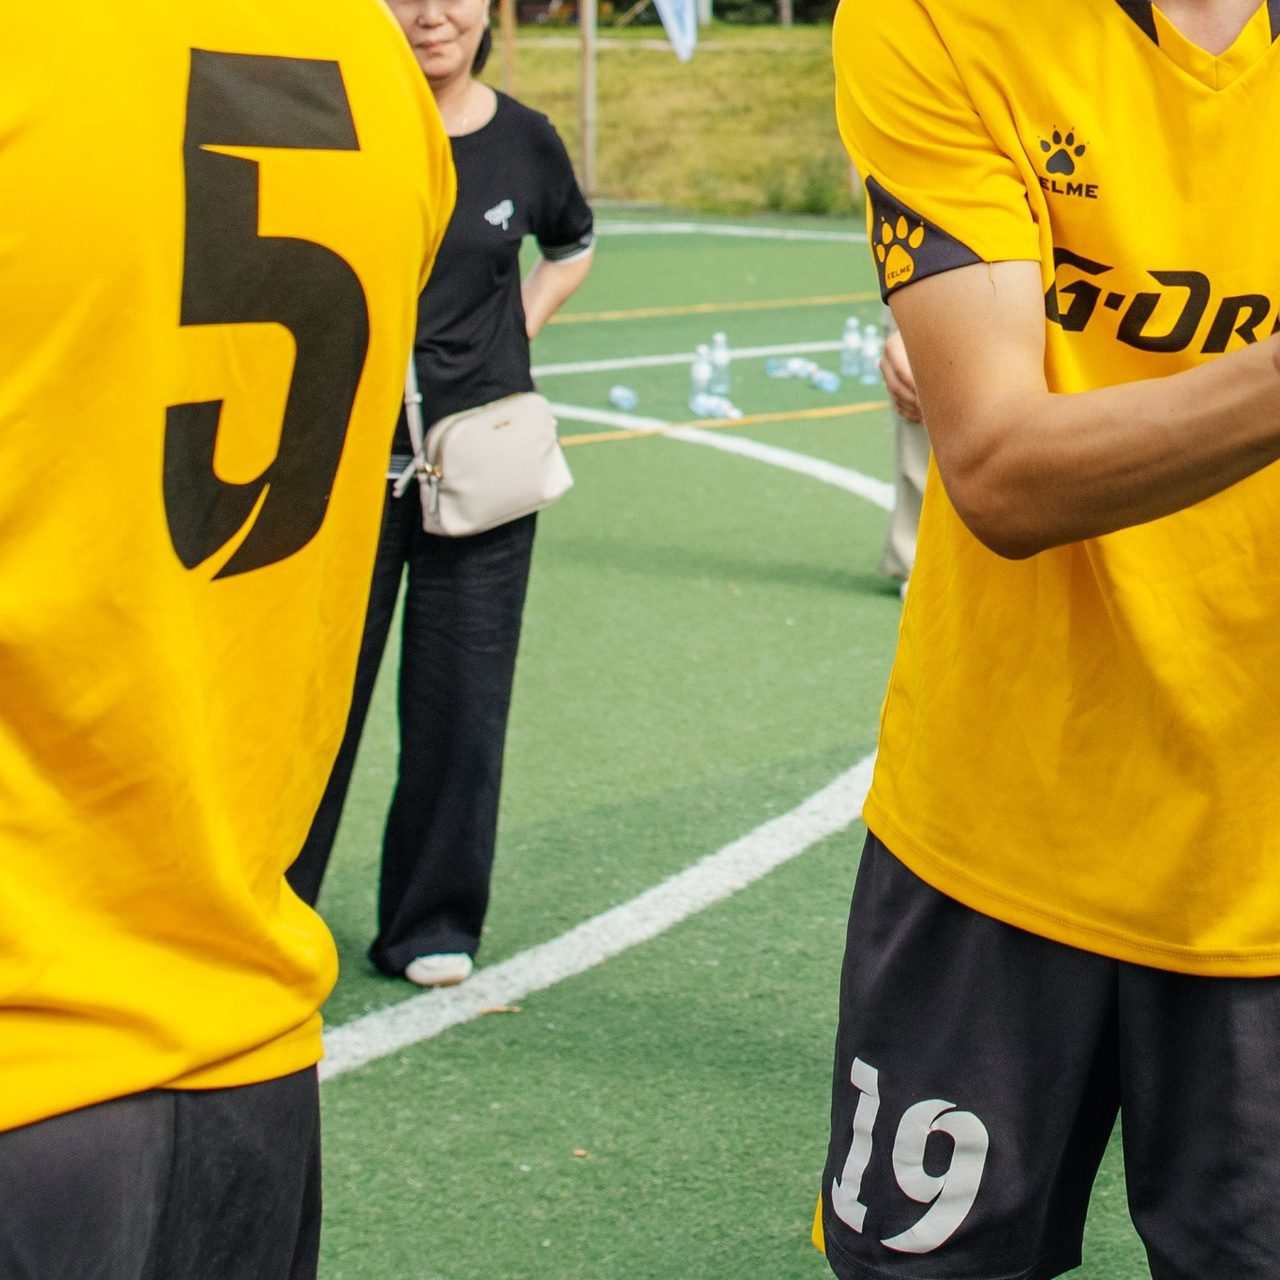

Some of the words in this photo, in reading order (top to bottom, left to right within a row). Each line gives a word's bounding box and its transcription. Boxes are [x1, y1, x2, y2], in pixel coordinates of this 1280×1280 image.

[1038, 176, 1099, 200] ELME
[161, 47, 371, 581] 5
[831, 1056, 989, 1254] 19
